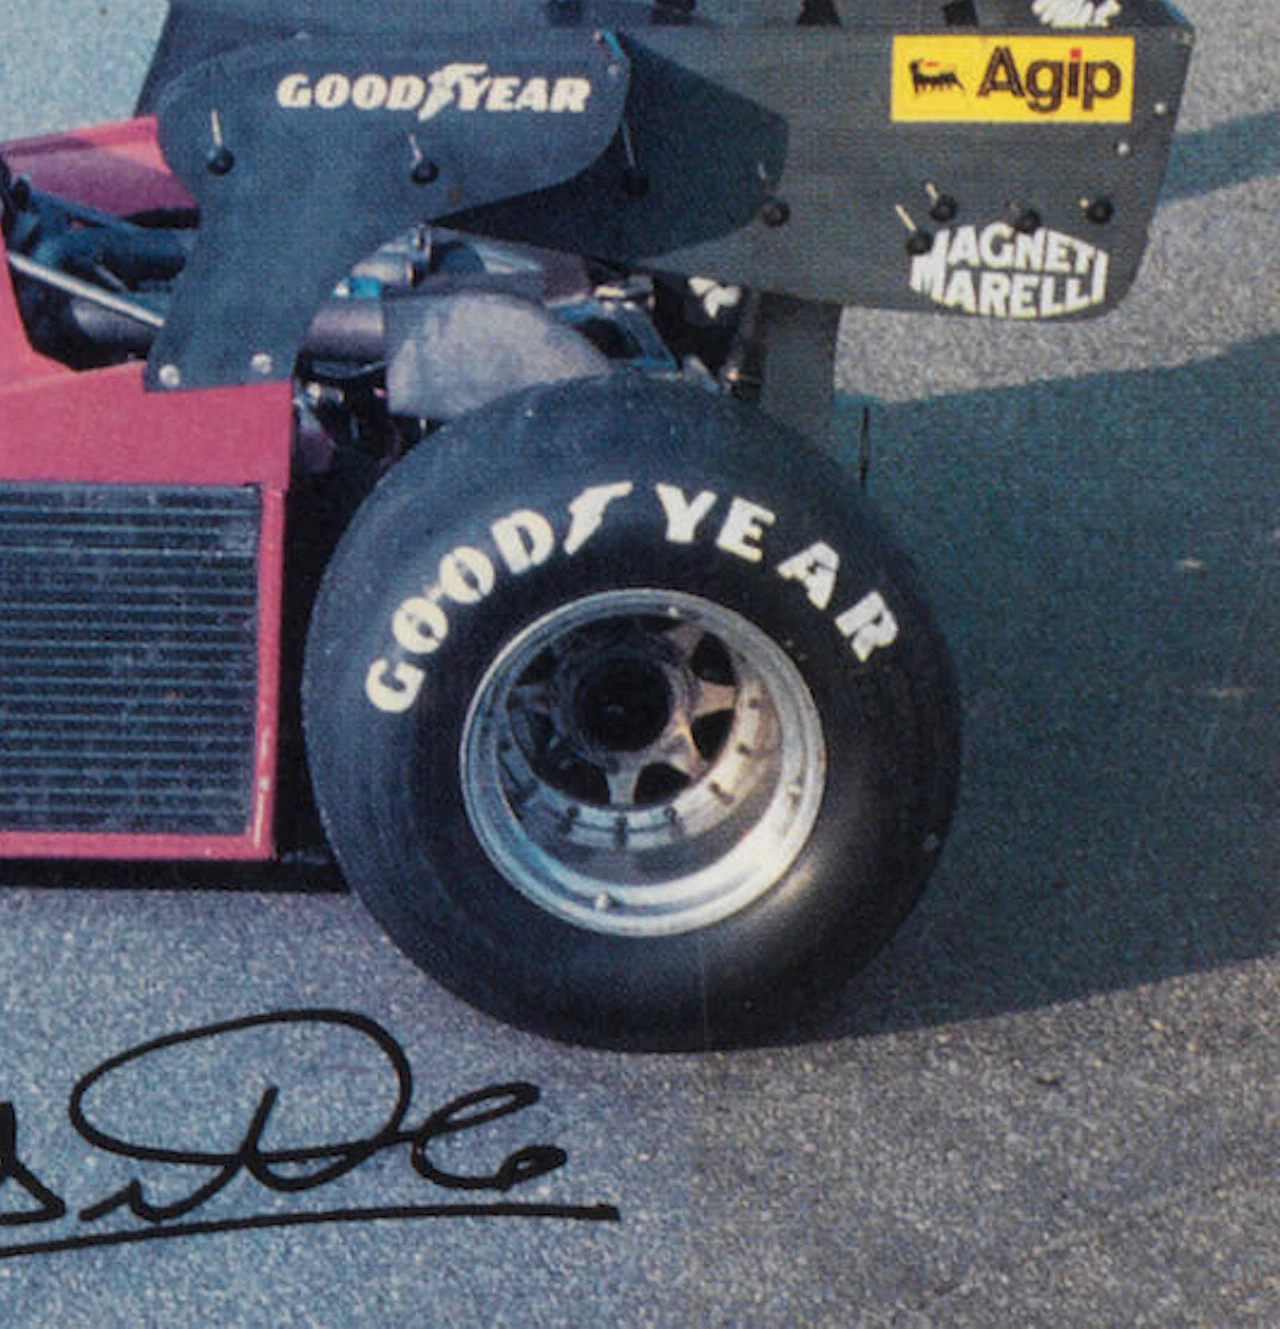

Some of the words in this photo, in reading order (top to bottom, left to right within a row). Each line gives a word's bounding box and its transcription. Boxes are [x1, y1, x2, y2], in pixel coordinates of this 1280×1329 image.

[976, 45, 1122, 113] Agip
[910, 221, 1109, 290] MAGNETI
[910, 257, 1109, 319] MARELLI
